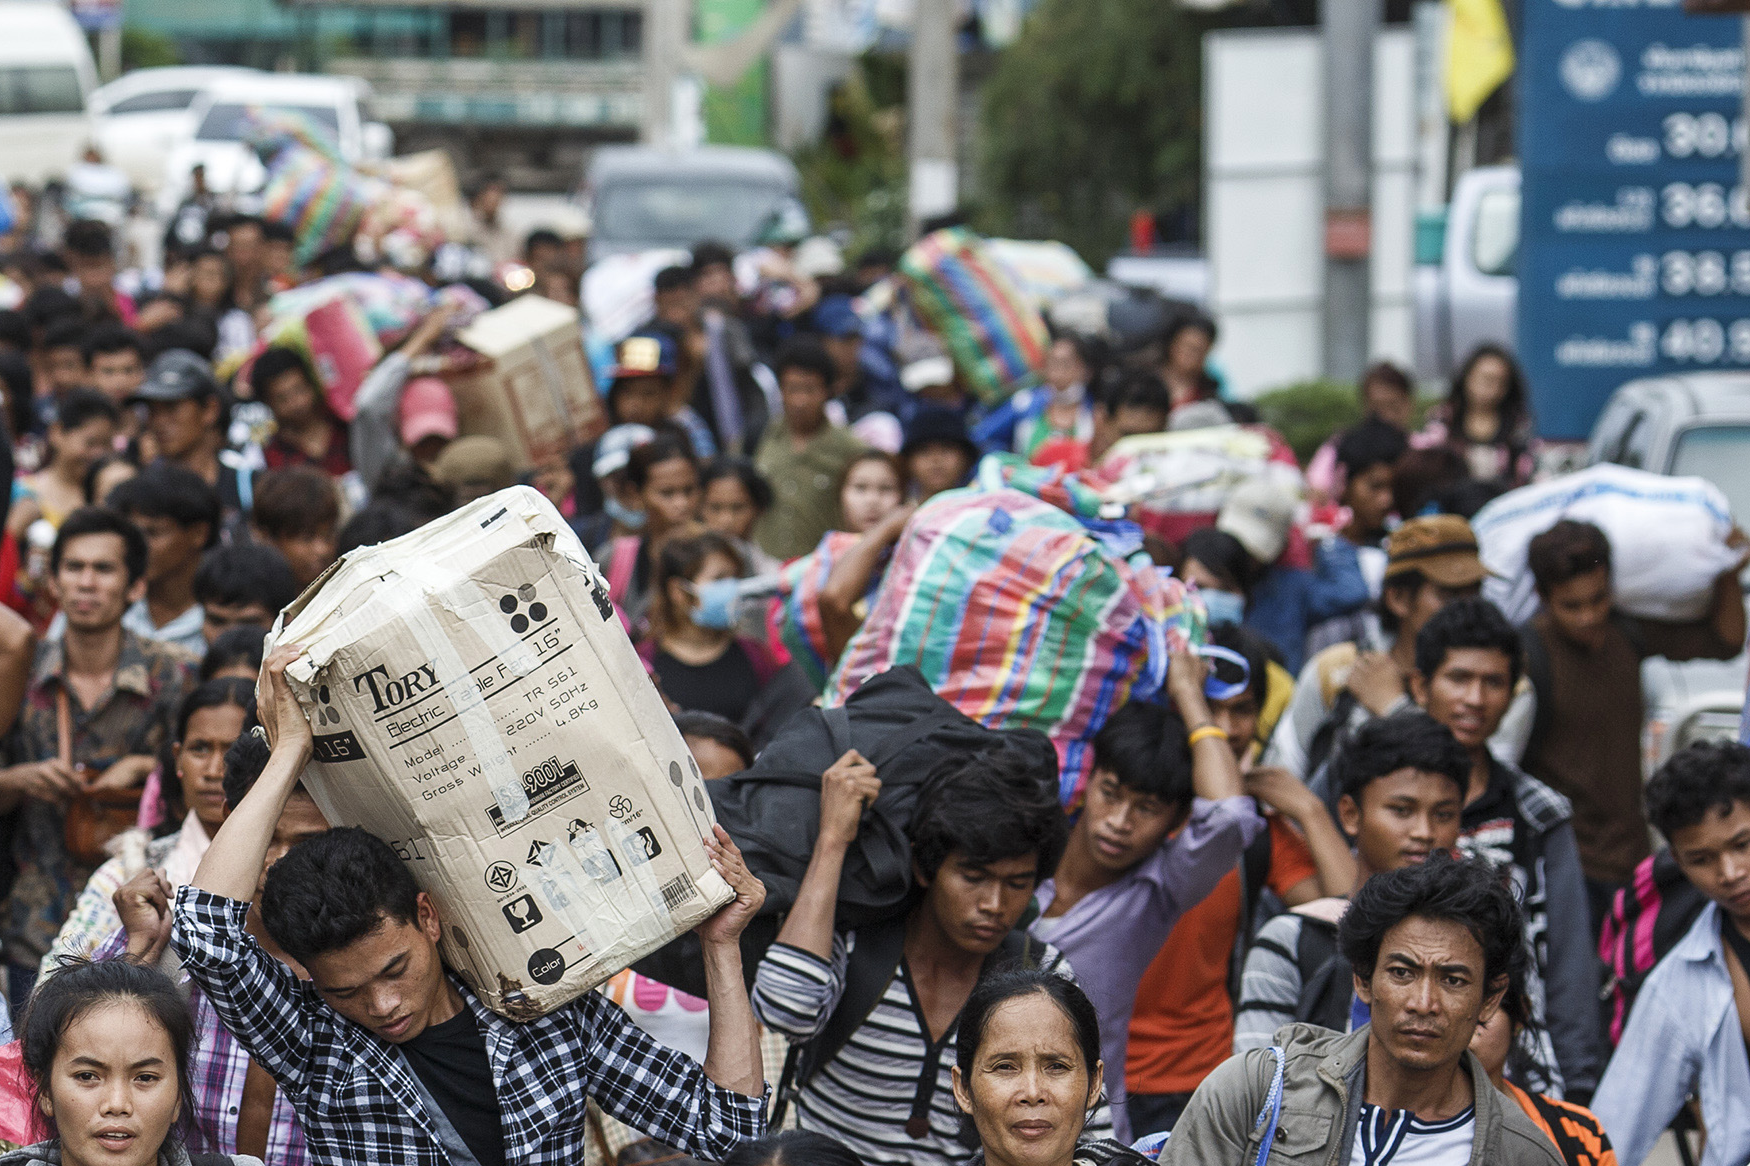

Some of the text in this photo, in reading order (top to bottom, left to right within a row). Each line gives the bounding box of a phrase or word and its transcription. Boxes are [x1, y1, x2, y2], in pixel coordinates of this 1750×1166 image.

[353, 658, 441, 714] TORY
[386, 705, 446, 738] Electric
[404, 743, 445, 768] Model
[523, 686, 545, 703] TR
[412, 755, 466, 784] Voltage
[506, 707, 544, 736] 220V
[421, 778, 464, 801] Gross
[555, 699, 599, 728] 4.8Kg
[531, 803, 549, 815] QUALITY
[549, 793, 568, 807] CONTROL
[568, 783, 585, 796] SYSTEM
[531, 957, 562, 978] Color
